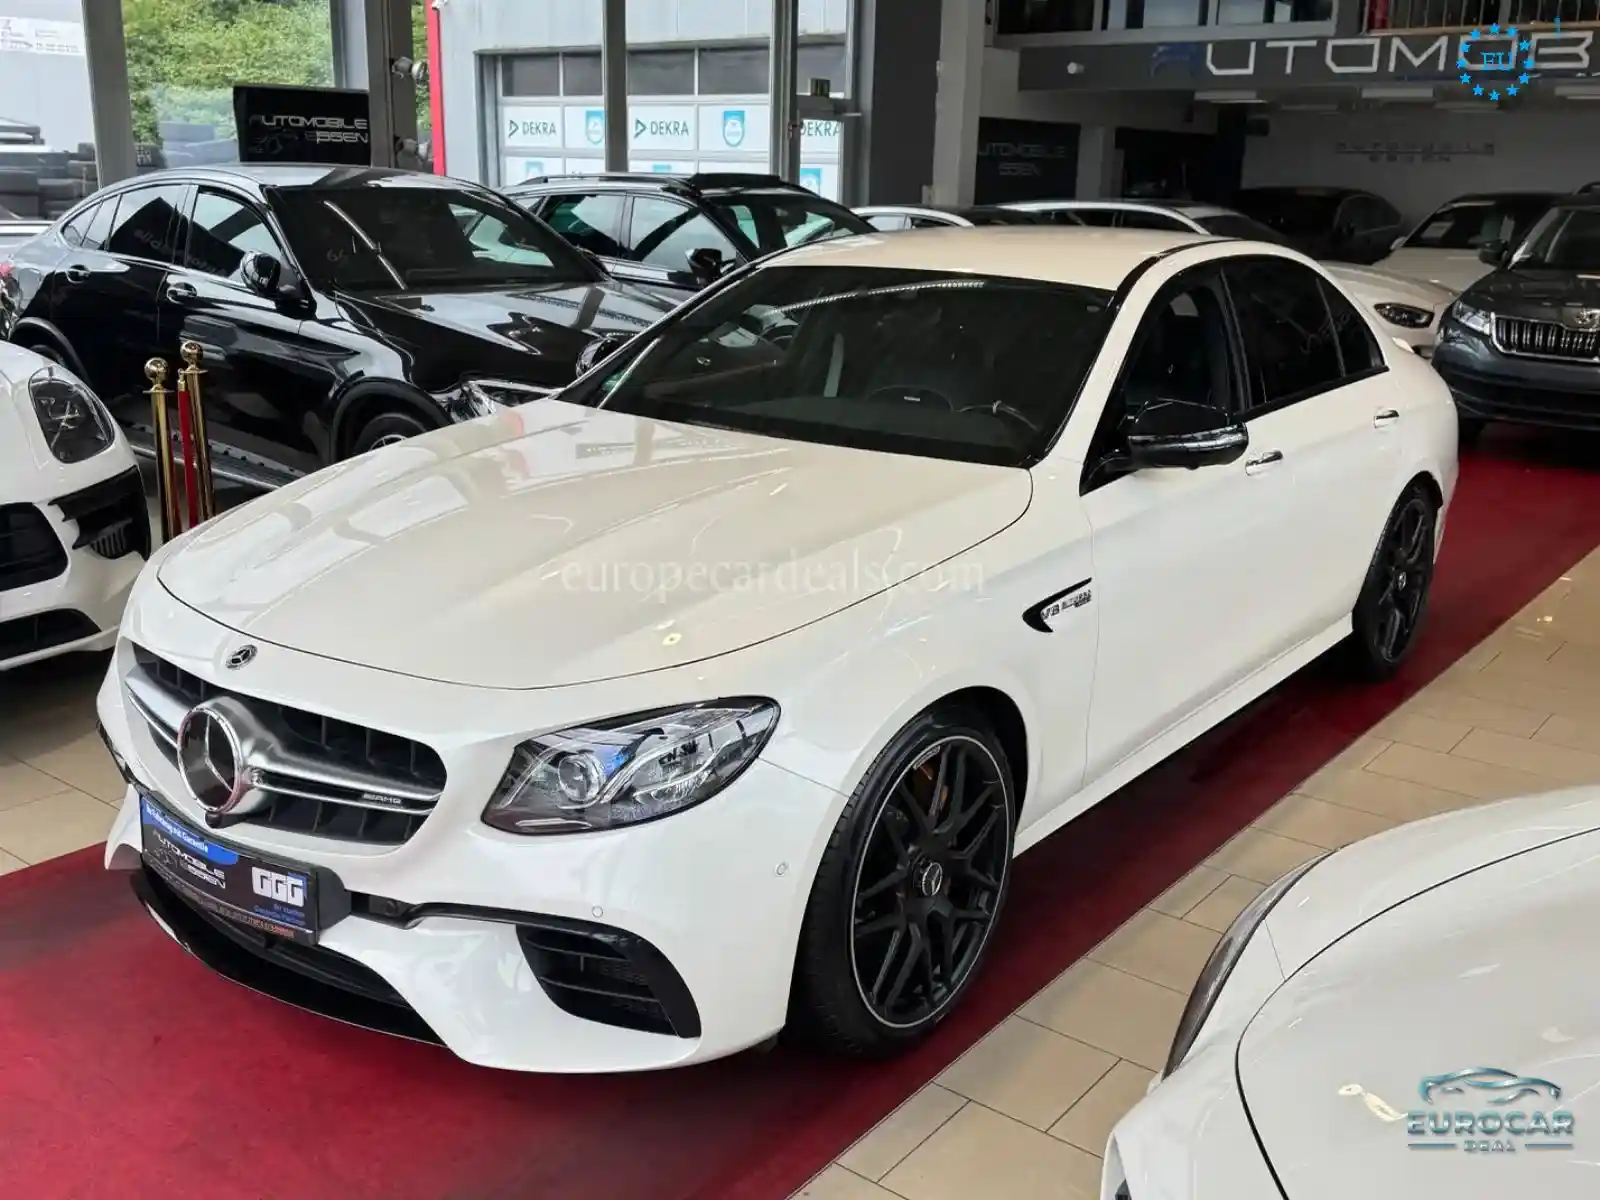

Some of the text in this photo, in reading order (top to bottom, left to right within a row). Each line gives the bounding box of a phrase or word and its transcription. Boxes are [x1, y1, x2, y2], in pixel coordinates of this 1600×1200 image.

[522, 121, 557, 136] DEKRA
[650, 120, 690, 136] DEKRA
[252, 867, 304, 908] GGG
